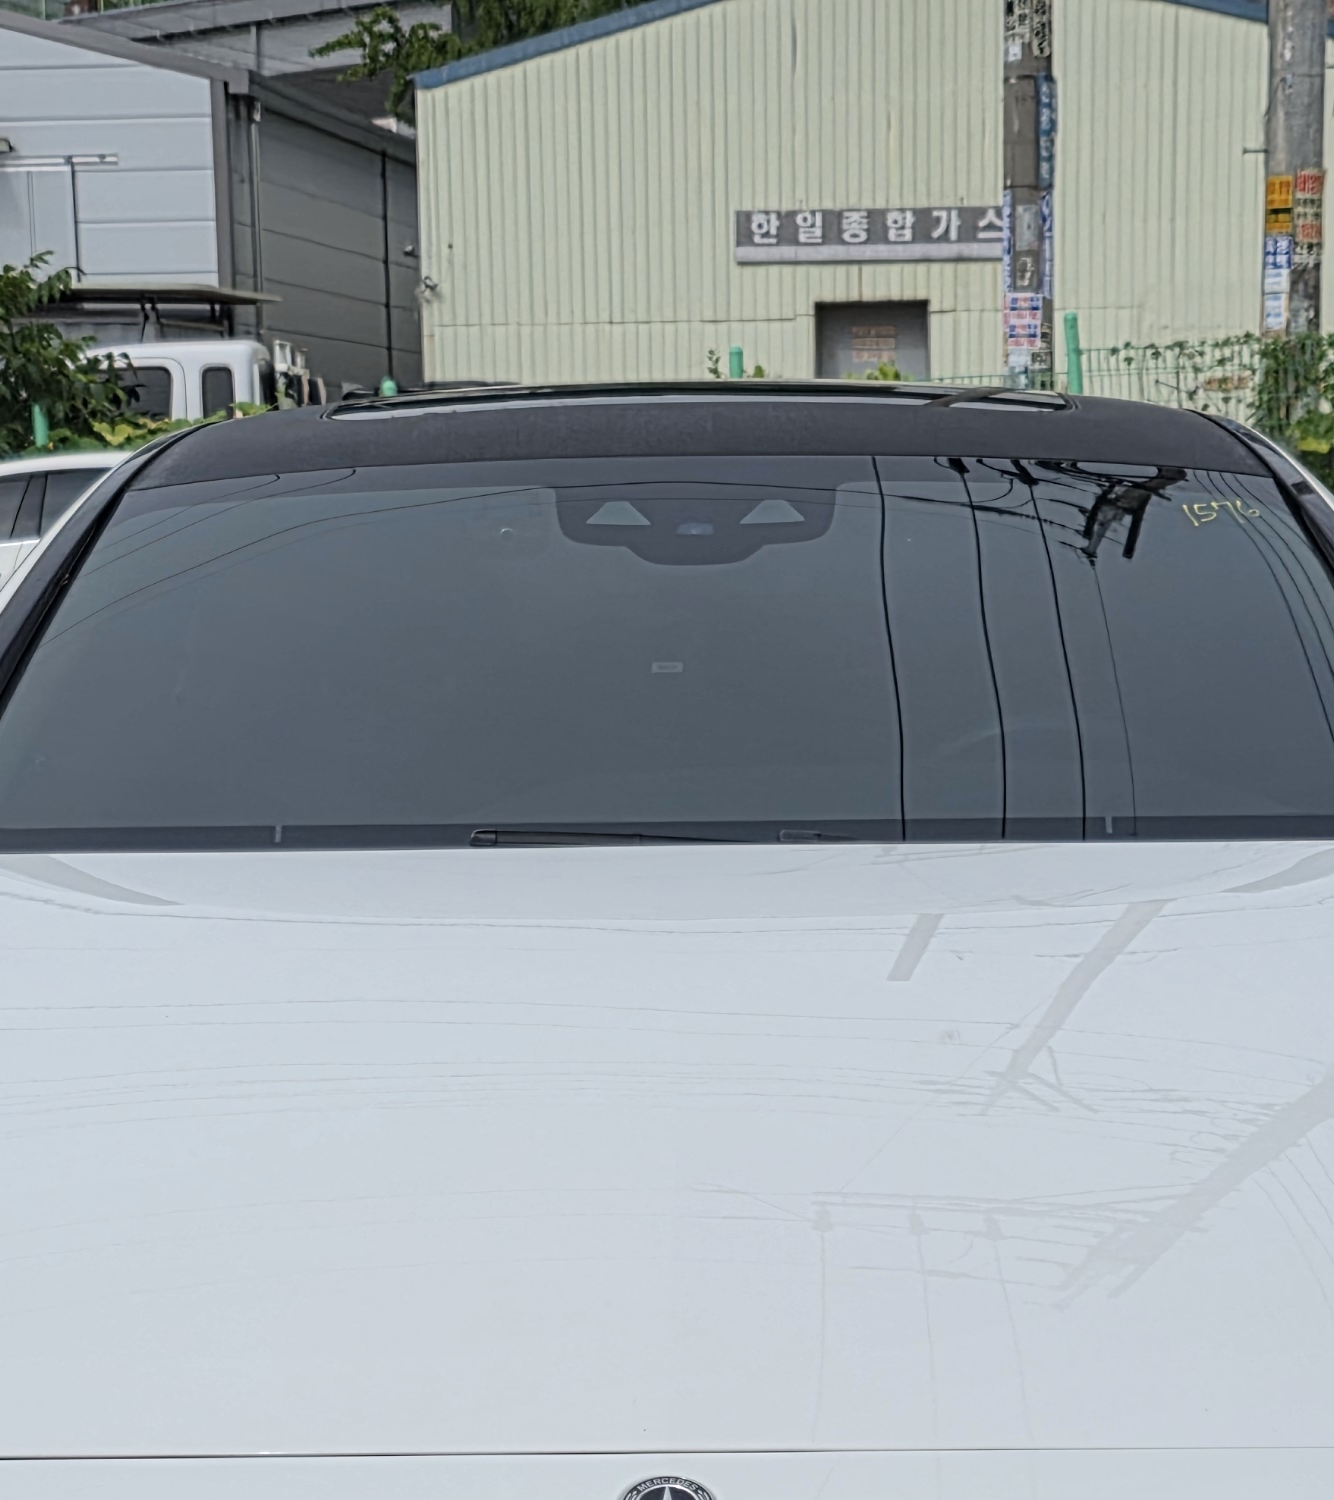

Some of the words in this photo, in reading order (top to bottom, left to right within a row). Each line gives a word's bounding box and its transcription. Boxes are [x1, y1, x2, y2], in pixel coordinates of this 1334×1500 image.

[751, 208, 1004, 245] 한일종합가스
[1182, 499, 1260, 527] 1576
[637, 1477, 699, 1492] MERCEDES
